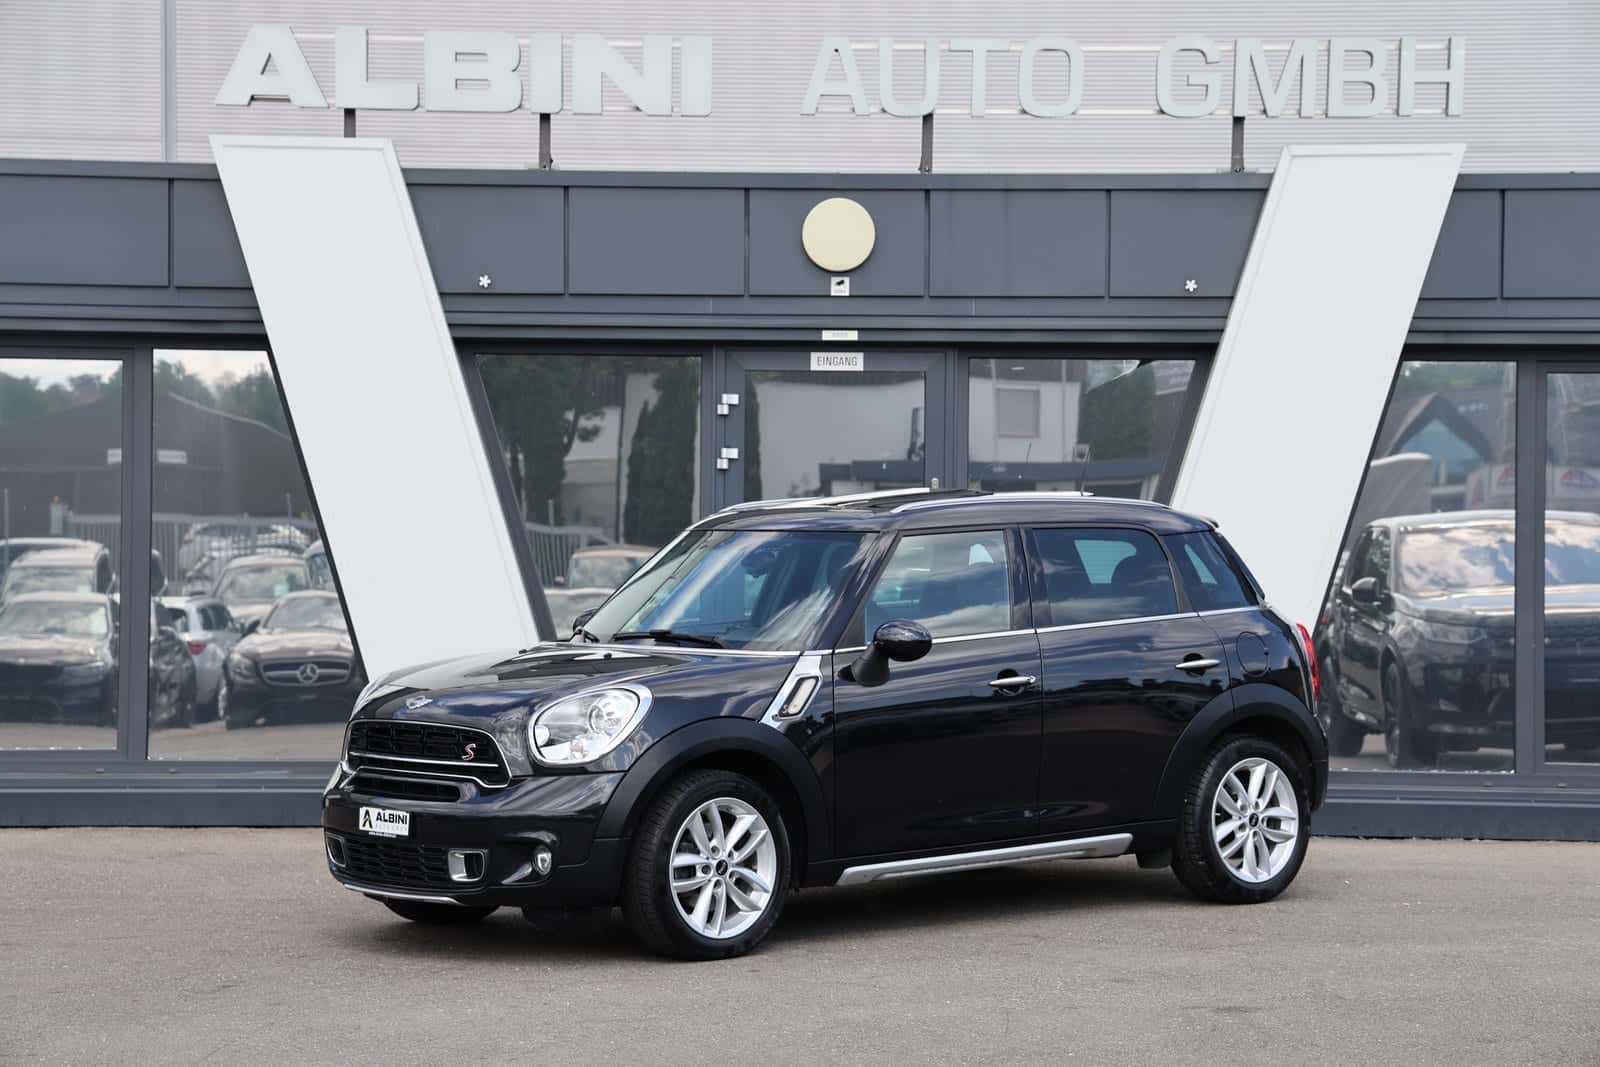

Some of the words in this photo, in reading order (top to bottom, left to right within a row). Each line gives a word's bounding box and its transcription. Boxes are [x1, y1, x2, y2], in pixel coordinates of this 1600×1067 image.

[215, 25, 713, 117] ALBINI
[801, 36, 1085, 118] AUTO
[1155, 36, 1466, 118] GMBH
[817, 356, 858, 367] EINGANG
[376, 811, 407, 824] ALBINI
